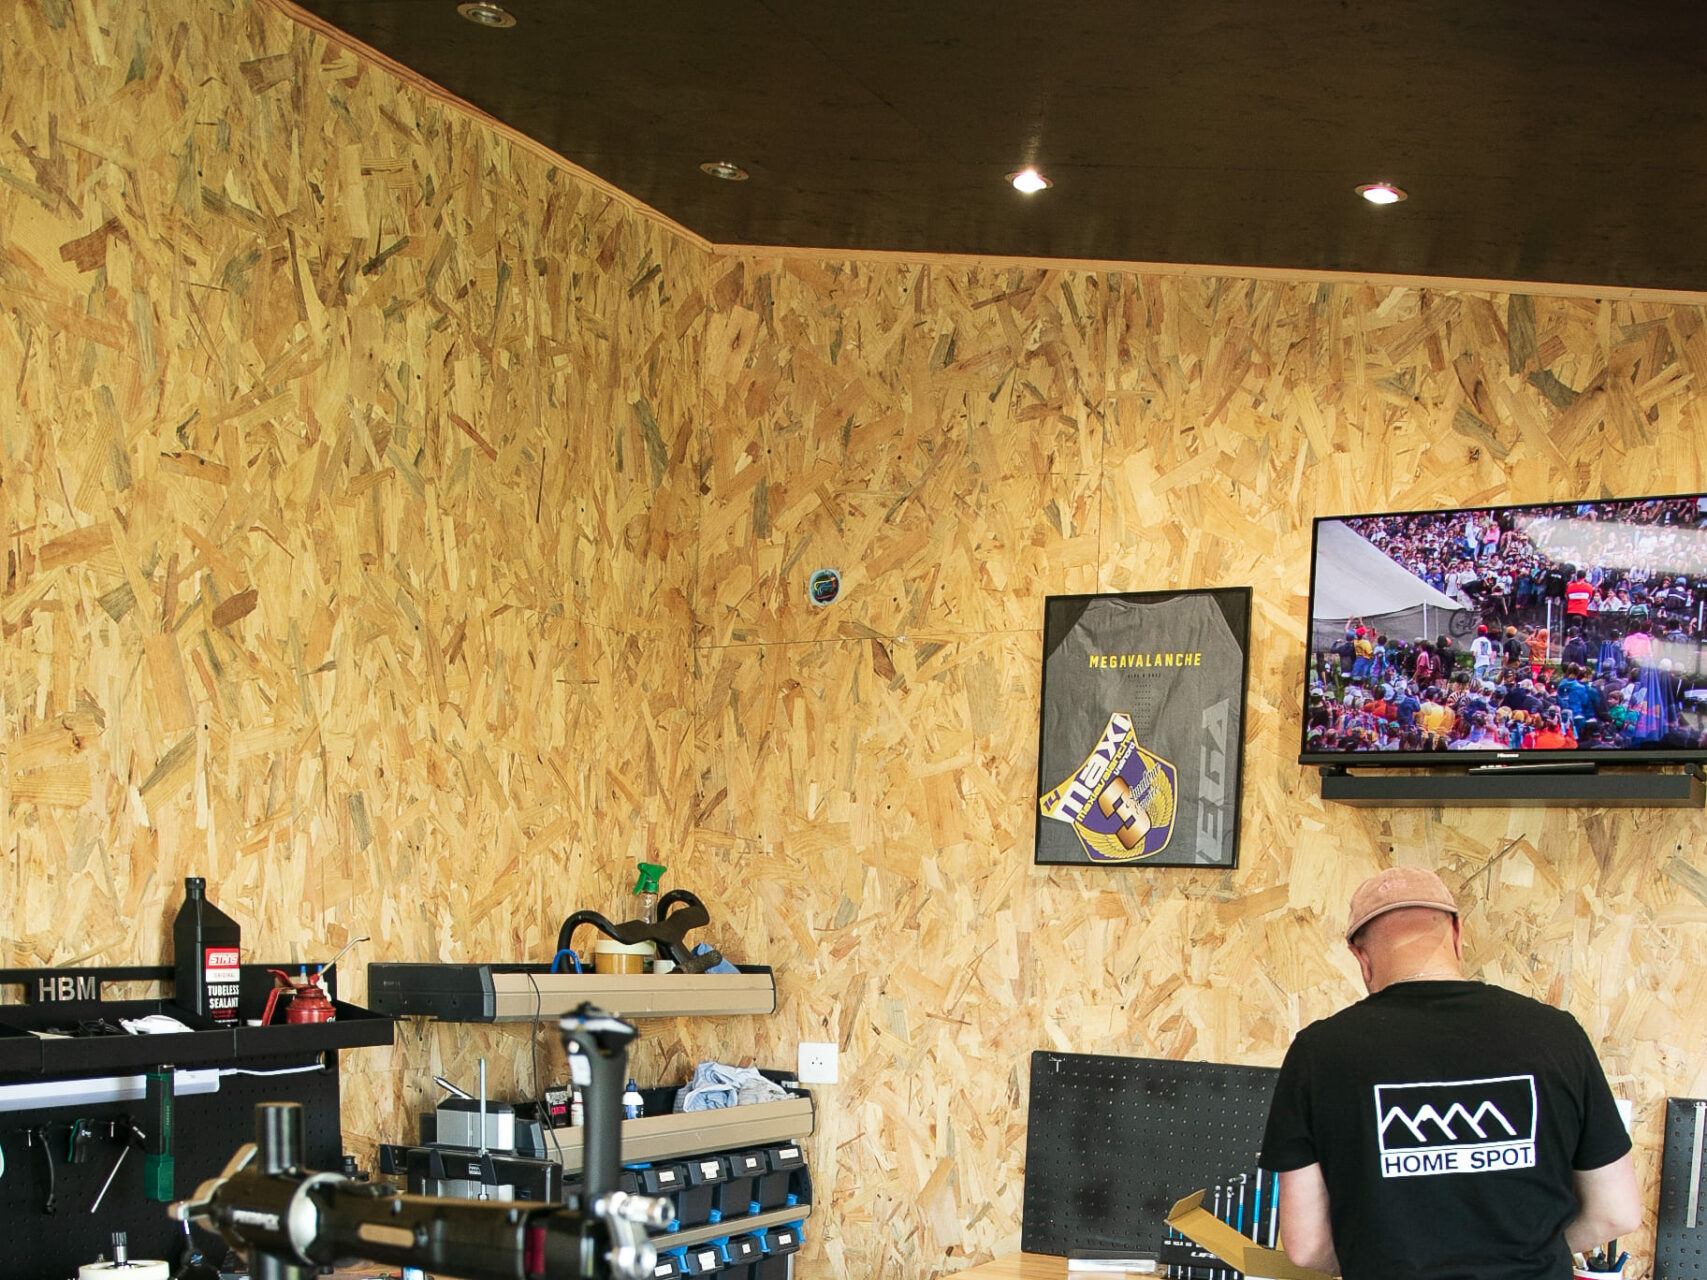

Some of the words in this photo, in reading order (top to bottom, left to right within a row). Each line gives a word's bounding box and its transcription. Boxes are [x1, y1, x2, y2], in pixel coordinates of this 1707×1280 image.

[1089, 652, 1201, 668] MEGAVALANCHE
[1195, 698, 1229, 864] EGA
[1098, 775, 1152, 850] 3
[38, 976, 96, 1002] HBM
[208, 984, 240, 996] TUBELESS
[209, 996, 239, 1009] SEALANT
[1385, 1152, 1459, 1174] HOME
[1470, 1146, 1533, 1170] SPOT.
